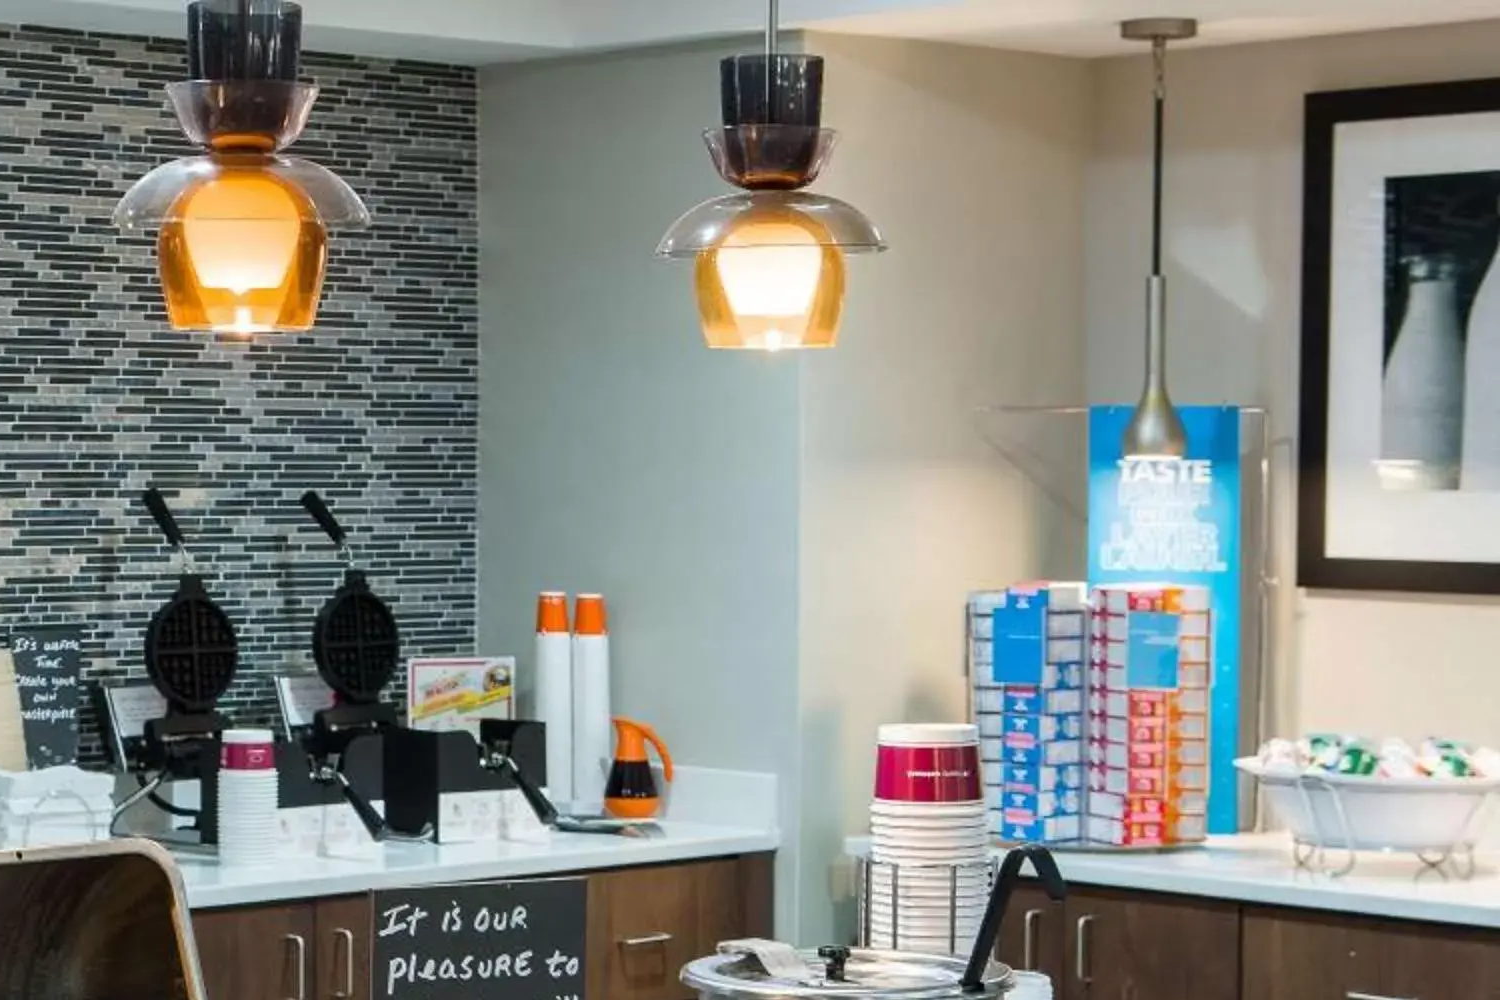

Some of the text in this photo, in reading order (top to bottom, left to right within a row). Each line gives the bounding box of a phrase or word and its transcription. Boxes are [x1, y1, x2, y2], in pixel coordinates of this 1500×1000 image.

[1116, 459, 1212, 482] TASTE
[379, 903, 428, 937] It
[441, 900, 462, 932] is
[545, 949, 579, 978] to
